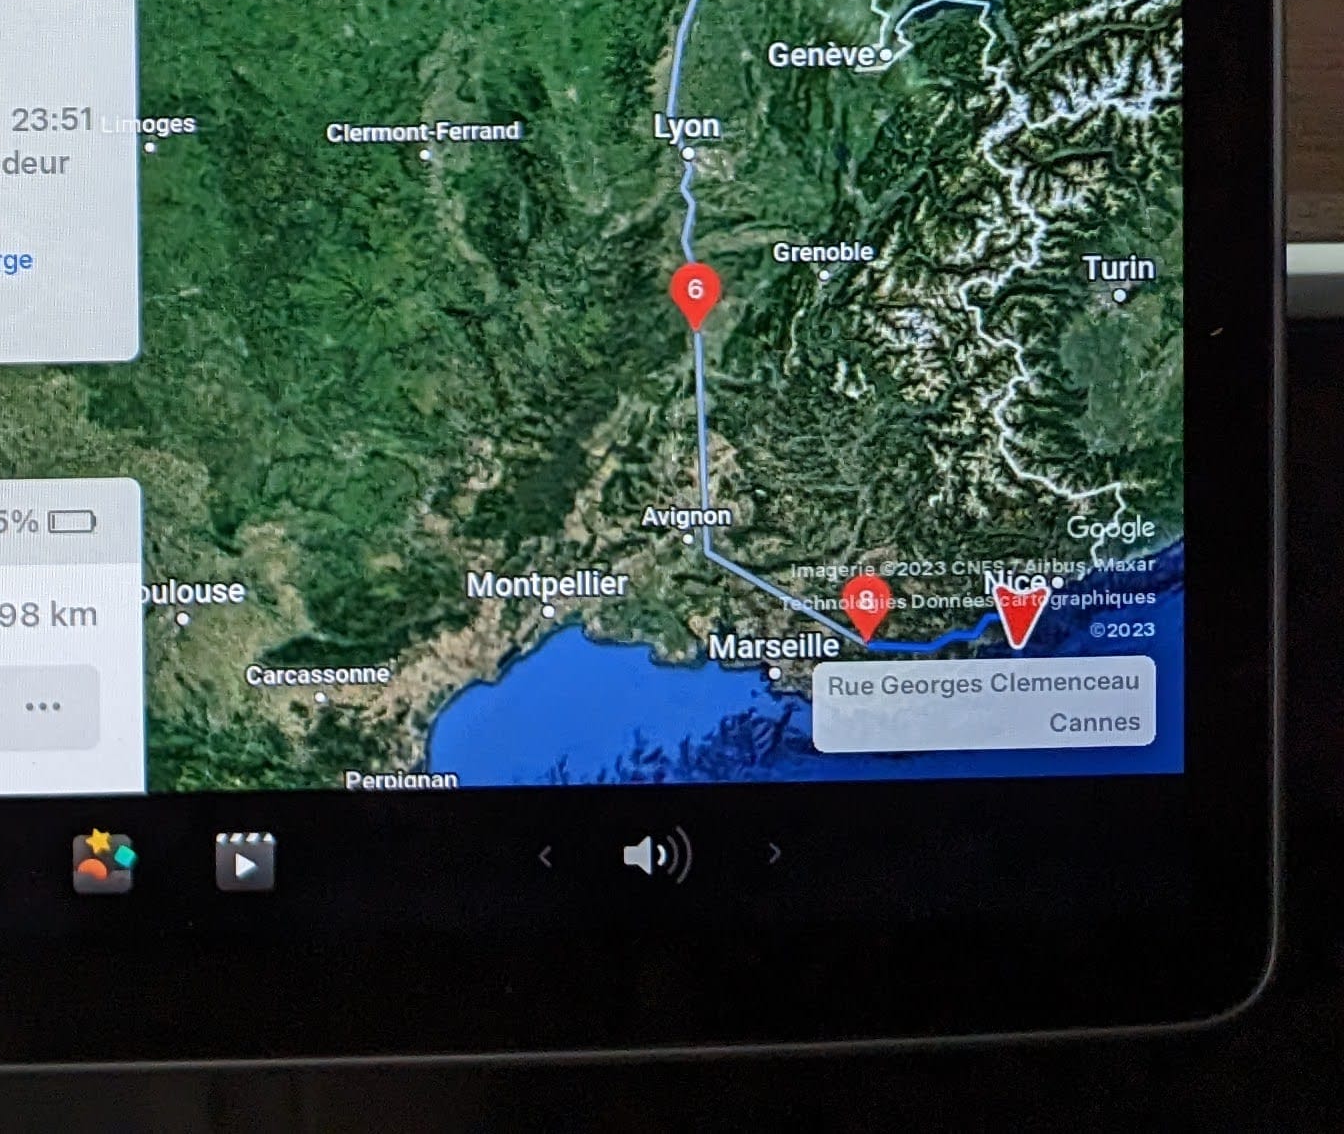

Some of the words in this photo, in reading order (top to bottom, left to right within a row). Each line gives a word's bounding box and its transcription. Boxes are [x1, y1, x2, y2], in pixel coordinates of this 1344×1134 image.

[768, 41, 875, 67] Genève
[11, 105, 94, 134] 23:51
[100, 113, 196, 136] Limoges
[653, 113, 721, 143] Lyon
[326, 121, 522, 143] Clermont-Ferrand
[773, 241, 874, 263] Grenoble
[1082, 255, 1156, 280] Turin
[687, 279, 703, 299] 6
[641, 506, 732, 528] Avignon
[1067, 515, 1156, 539] Google
[790, 562, 876, 579] Imagerie
[951, 560, 1004, 575] CNES
[1097, 557, 1156, 573] Maxar
[141, 580, 246, 605] oulouse
[467, 572, 629, 600] Montpellier
[983, 570, 1049, 595] Nice
[859, 590, 875, 610] 8
[911, 591, 994, 610] Données
[999, 589, 1157, 612] cartographiques
[49, 599, 99, 628] km
[1089, 621, 1157, 638] ©2023
[708, 634, 840, 661] Marseille
[245, 664, 391, 686] Carcassonne
[827, 675, 874, 696] Rue
[881, 674, 984, 699] Georges
[990, 672, 1141, 694] Clemenceau
[1049, 712, 1141, 734] Cannes
[345, 770, 459, 790] Perpignan
